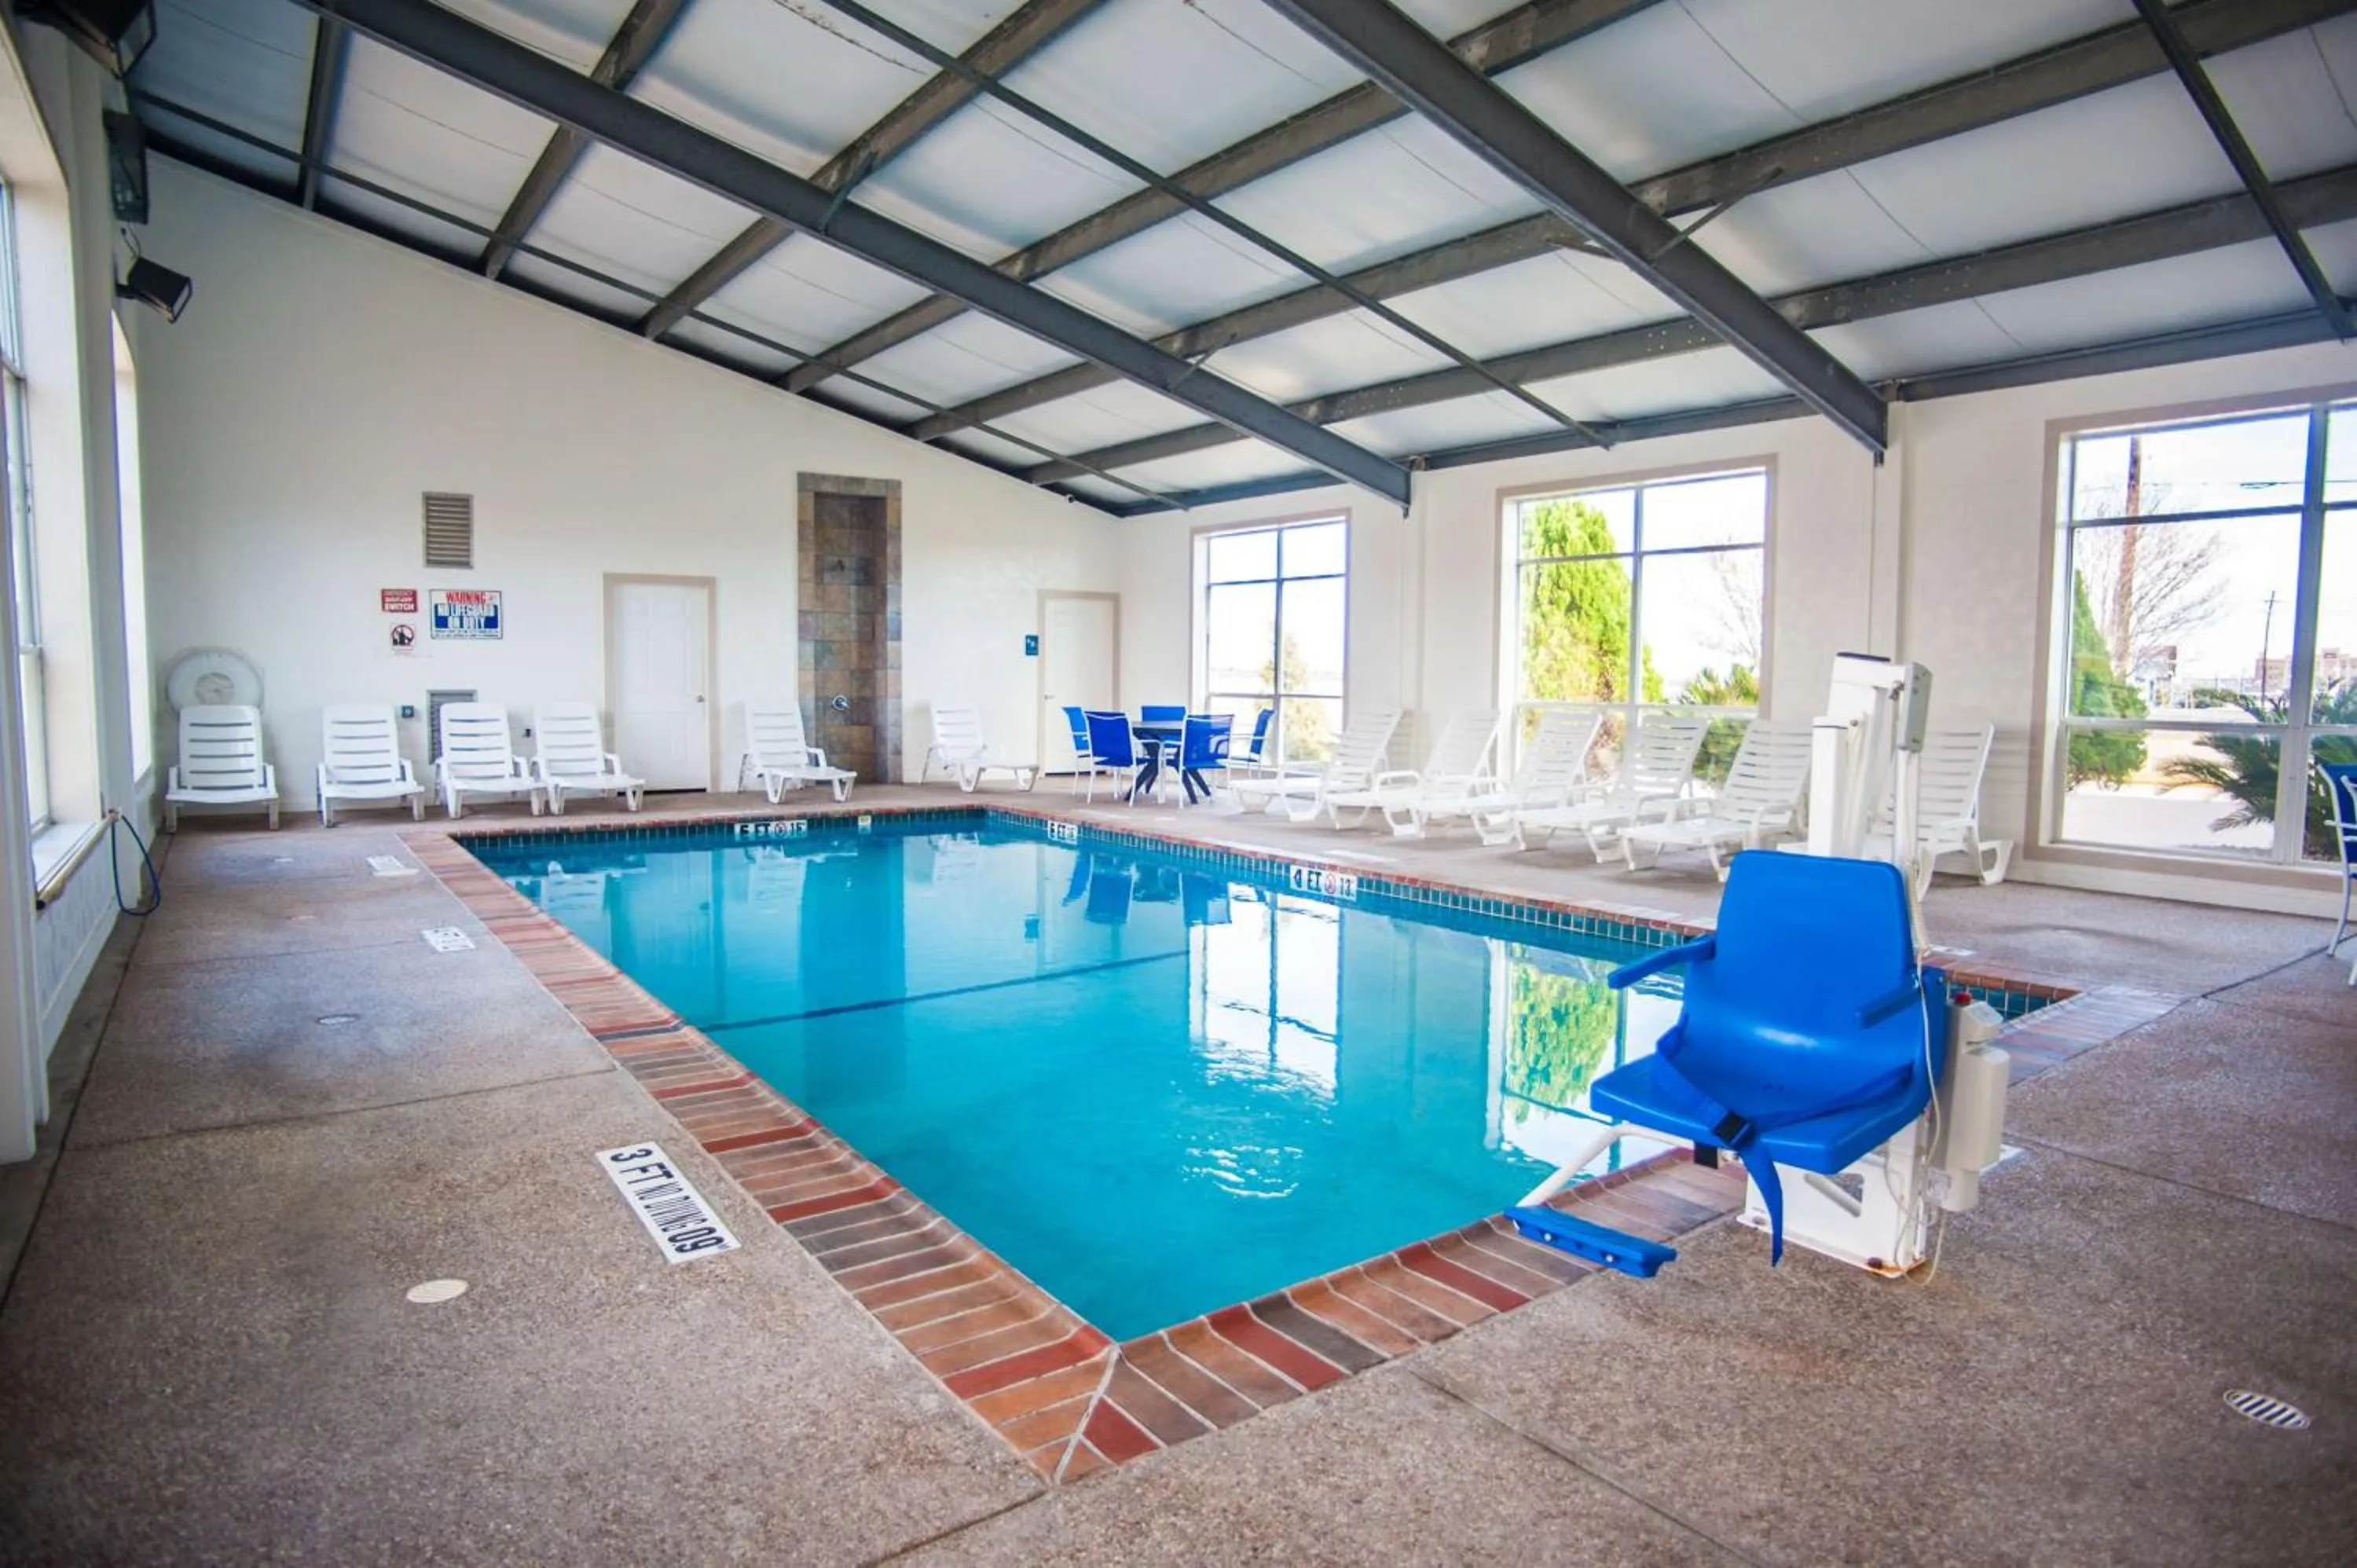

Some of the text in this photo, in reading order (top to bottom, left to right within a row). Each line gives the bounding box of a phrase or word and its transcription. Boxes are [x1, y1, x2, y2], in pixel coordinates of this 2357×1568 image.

[445, 591, 486, 604] WARNING
[451, 604, 495, 617] LIFEGUARD
[463, 617, 486, 628] DUTY
[610, 1148, 653, 1162] 3
[620, 1162, 674, 1185] FT
[633, 1181, 684, 1200] NO
[643, 1195, 709, 1233] DIVING
